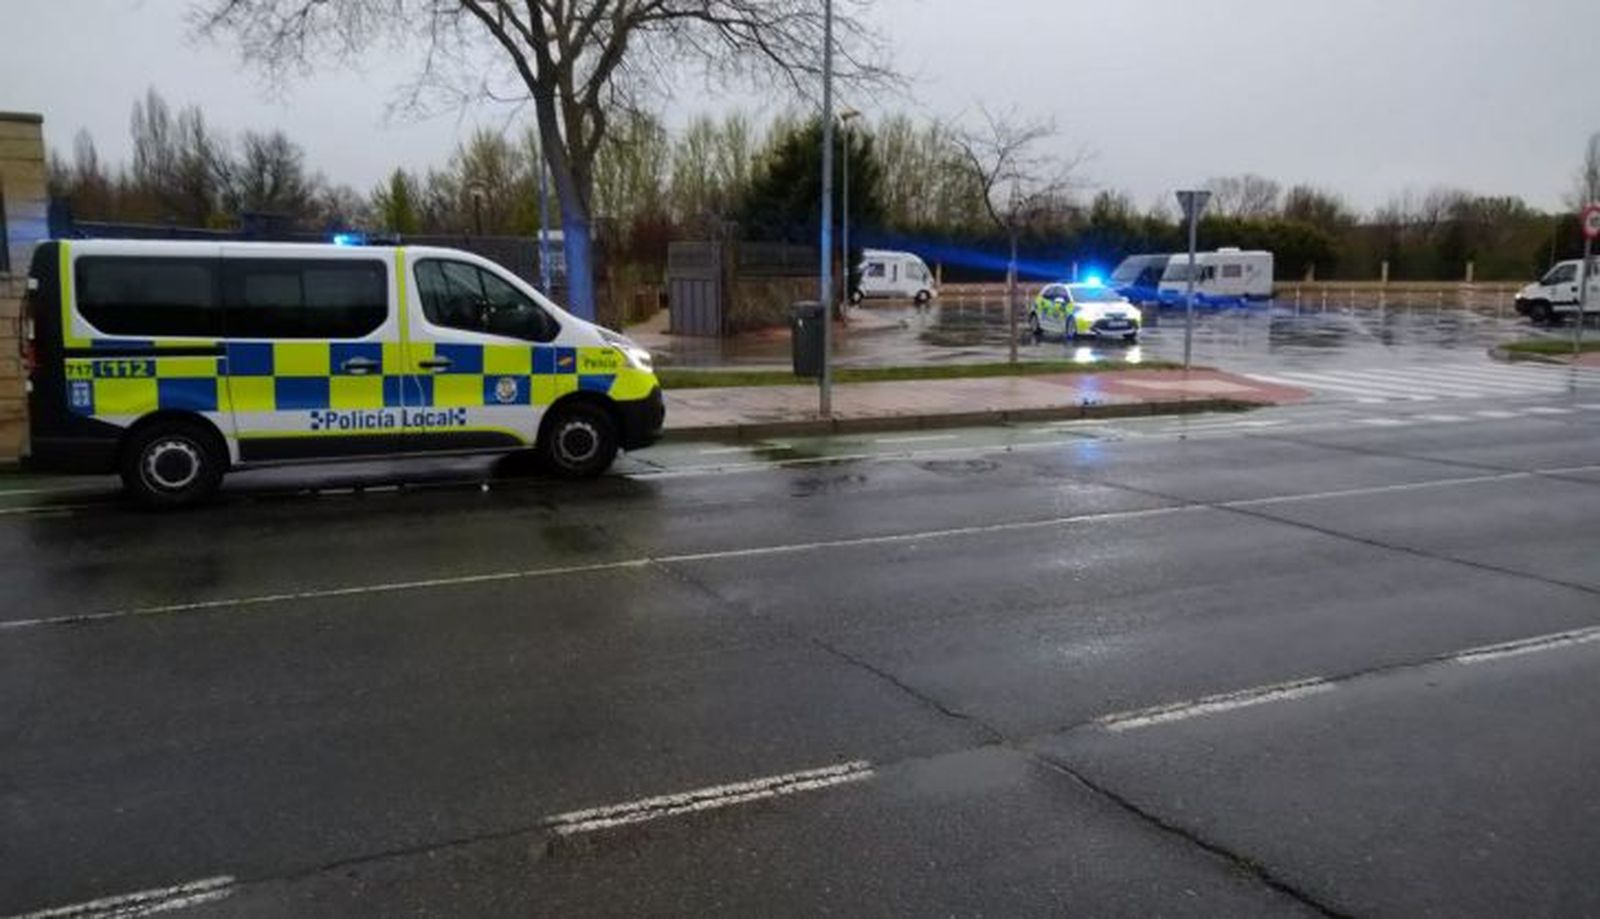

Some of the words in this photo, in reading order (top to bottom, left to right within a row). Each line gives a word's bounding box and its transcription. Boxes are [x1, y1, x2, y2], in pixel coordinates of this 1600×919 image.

[66, 363, 92, 376] 717
[325, 409, 395, 430] Policía
[402, 408, 455, 427] Local
